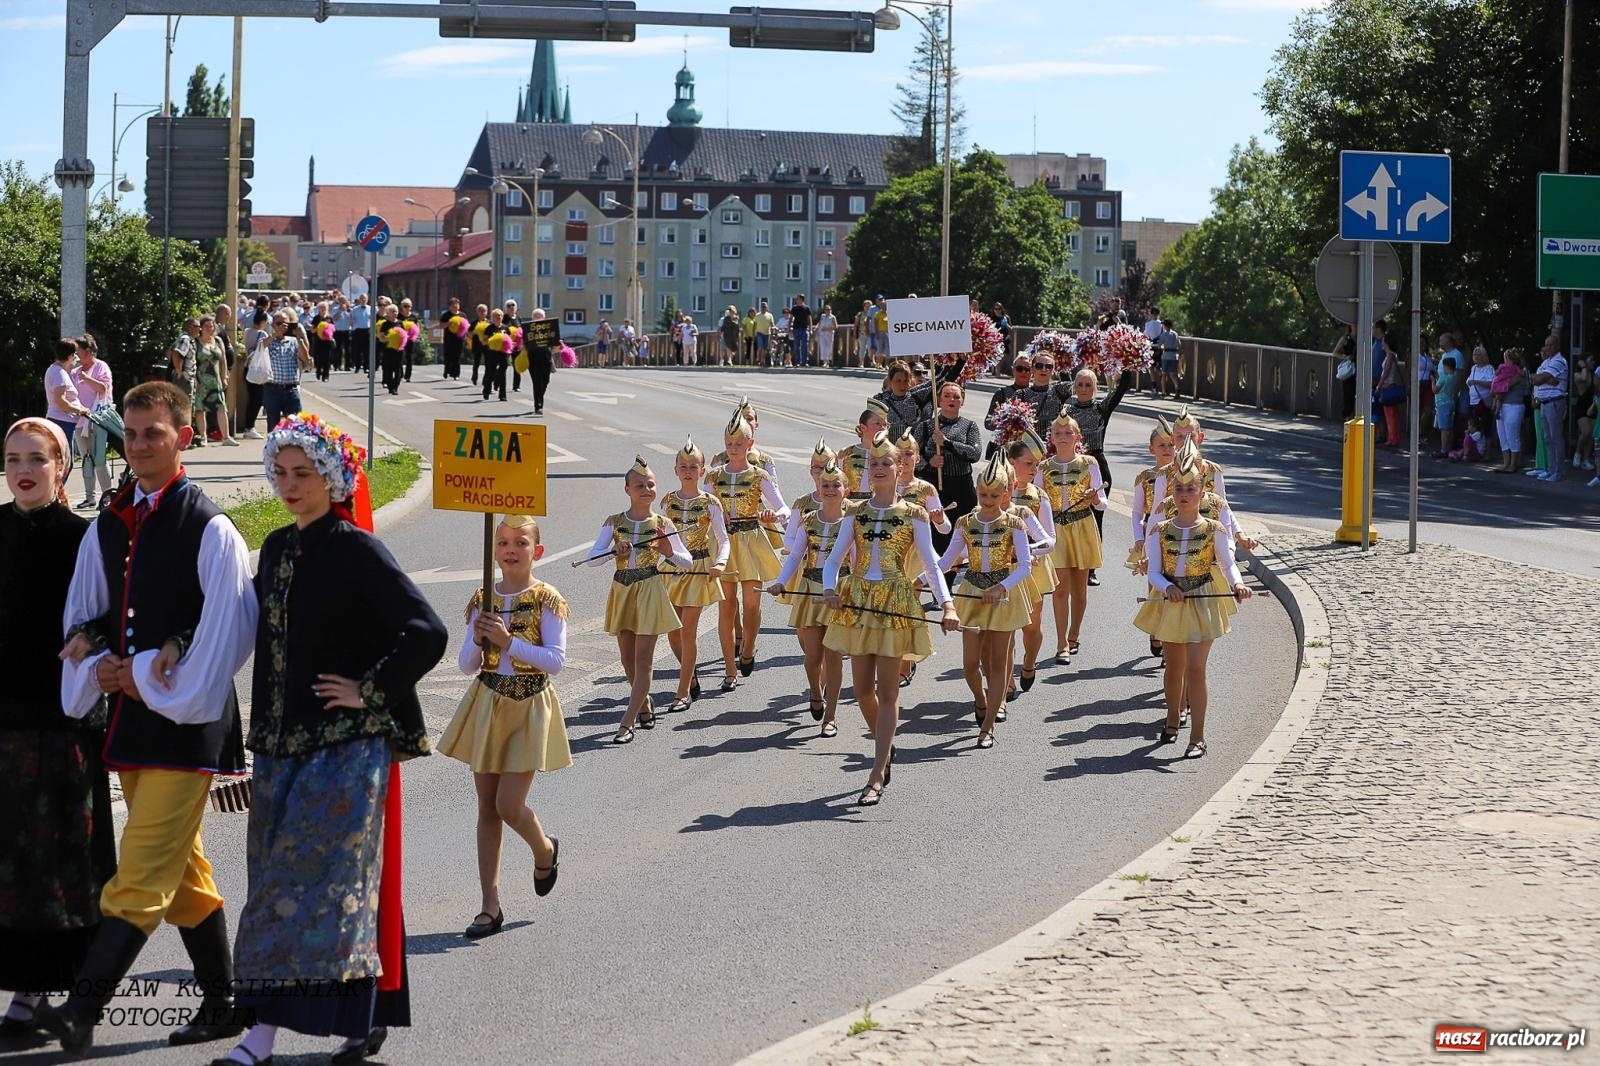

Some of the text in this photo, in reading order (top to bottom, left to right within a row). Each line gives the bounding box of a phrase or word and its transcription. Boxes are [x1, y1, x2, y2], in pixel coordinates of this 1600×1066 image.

[893, 319, 965, 333] SPEC MAMY
[444, 473, 495, 490] POWIAT
[463, 490, 535, 509] RACIBÓRZ
